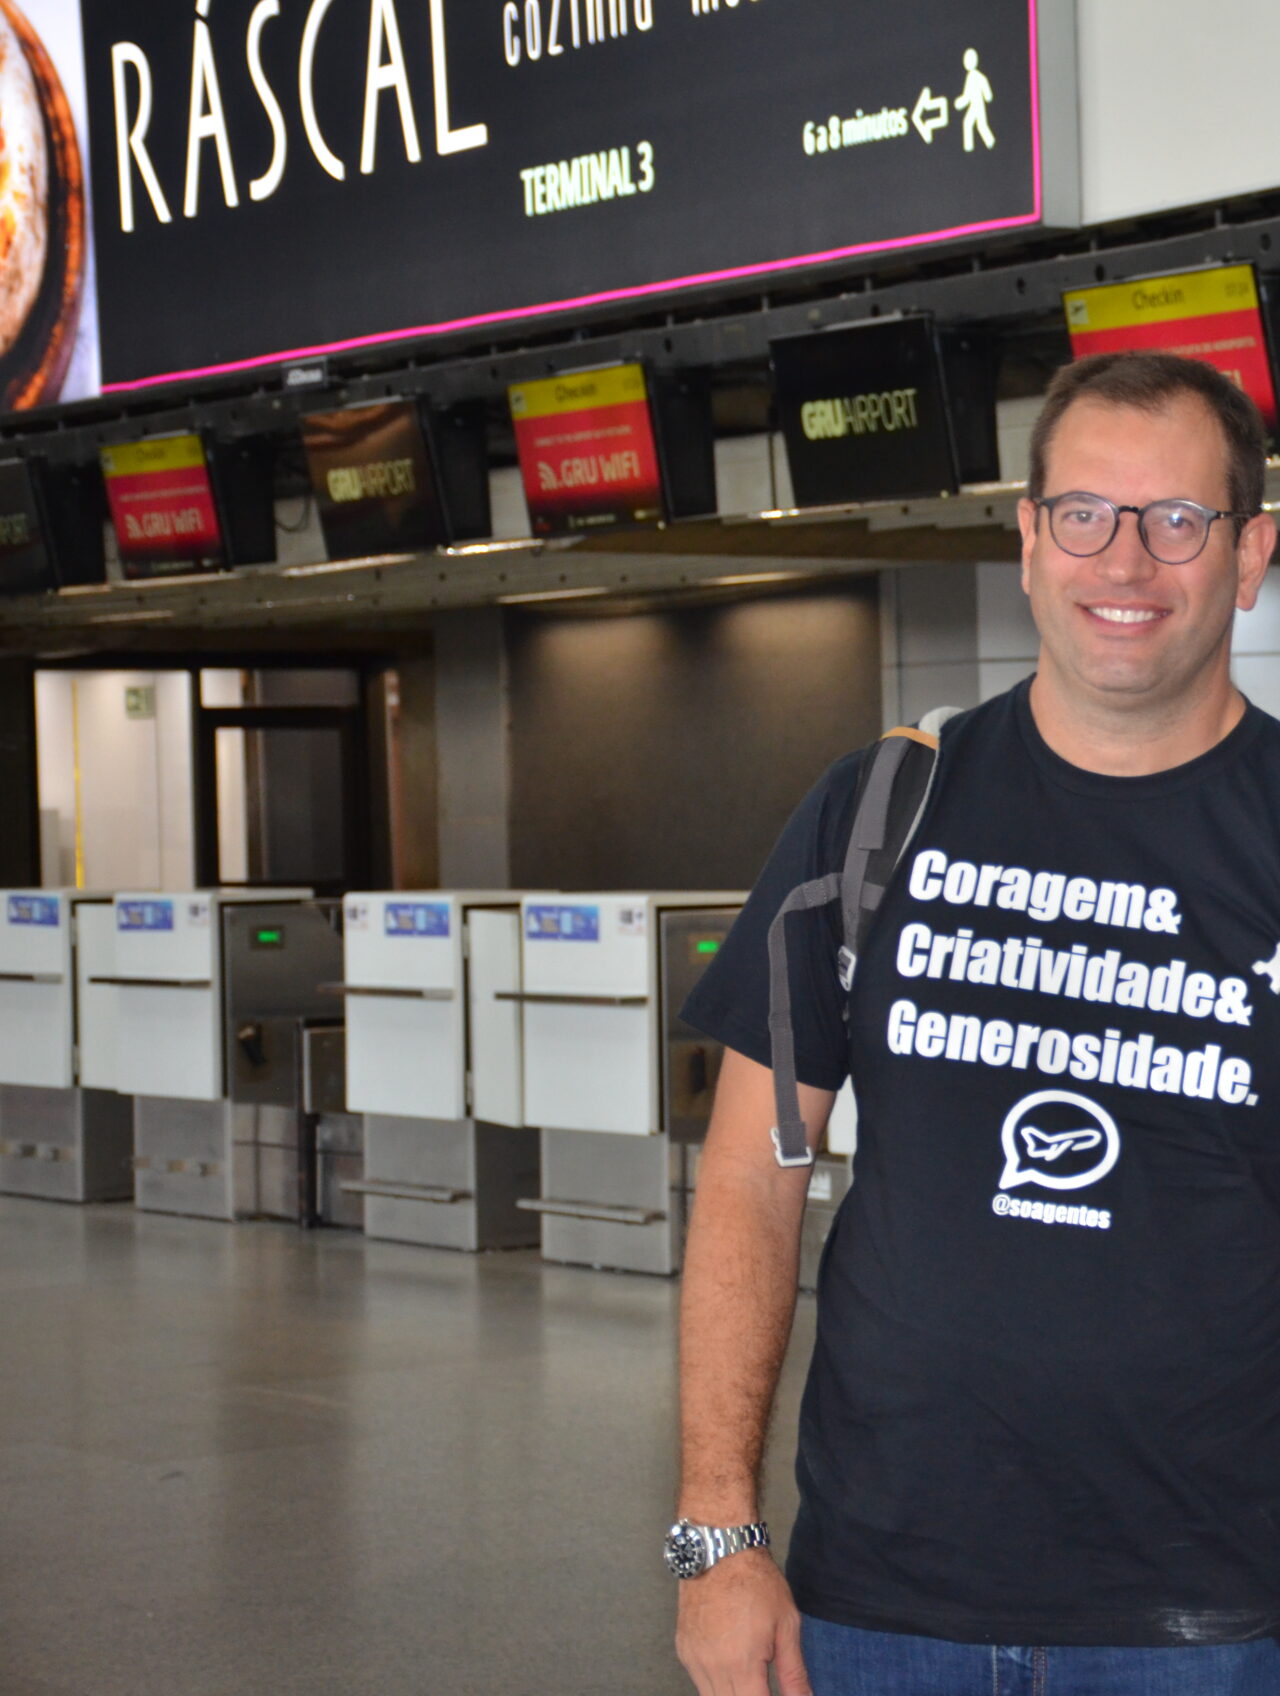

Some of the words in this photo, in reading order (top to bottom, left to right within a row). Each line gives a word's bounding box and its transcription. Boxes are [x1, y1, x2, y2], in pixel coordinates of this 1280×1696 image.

[110, 0, 489, 233] RÁSCAL
[803, 120, 816, 155] 6
[816, 125, 829, 153] a
[828, 115, 841, 150] 8
[841, 106, 909, 148] minutos
[519, 146, 637, 217] TERMINAL
[636, 140, 655, 193] 3
[560, 457, 599, 488] GRU
[908, 848, 1182, 934] Coragem&
[896, 923, 1253, 1026] Criatividade&
[887, 999, 1259, 1106] Generosidade.
[992, 1194, 1111, 1229] @soagentes
